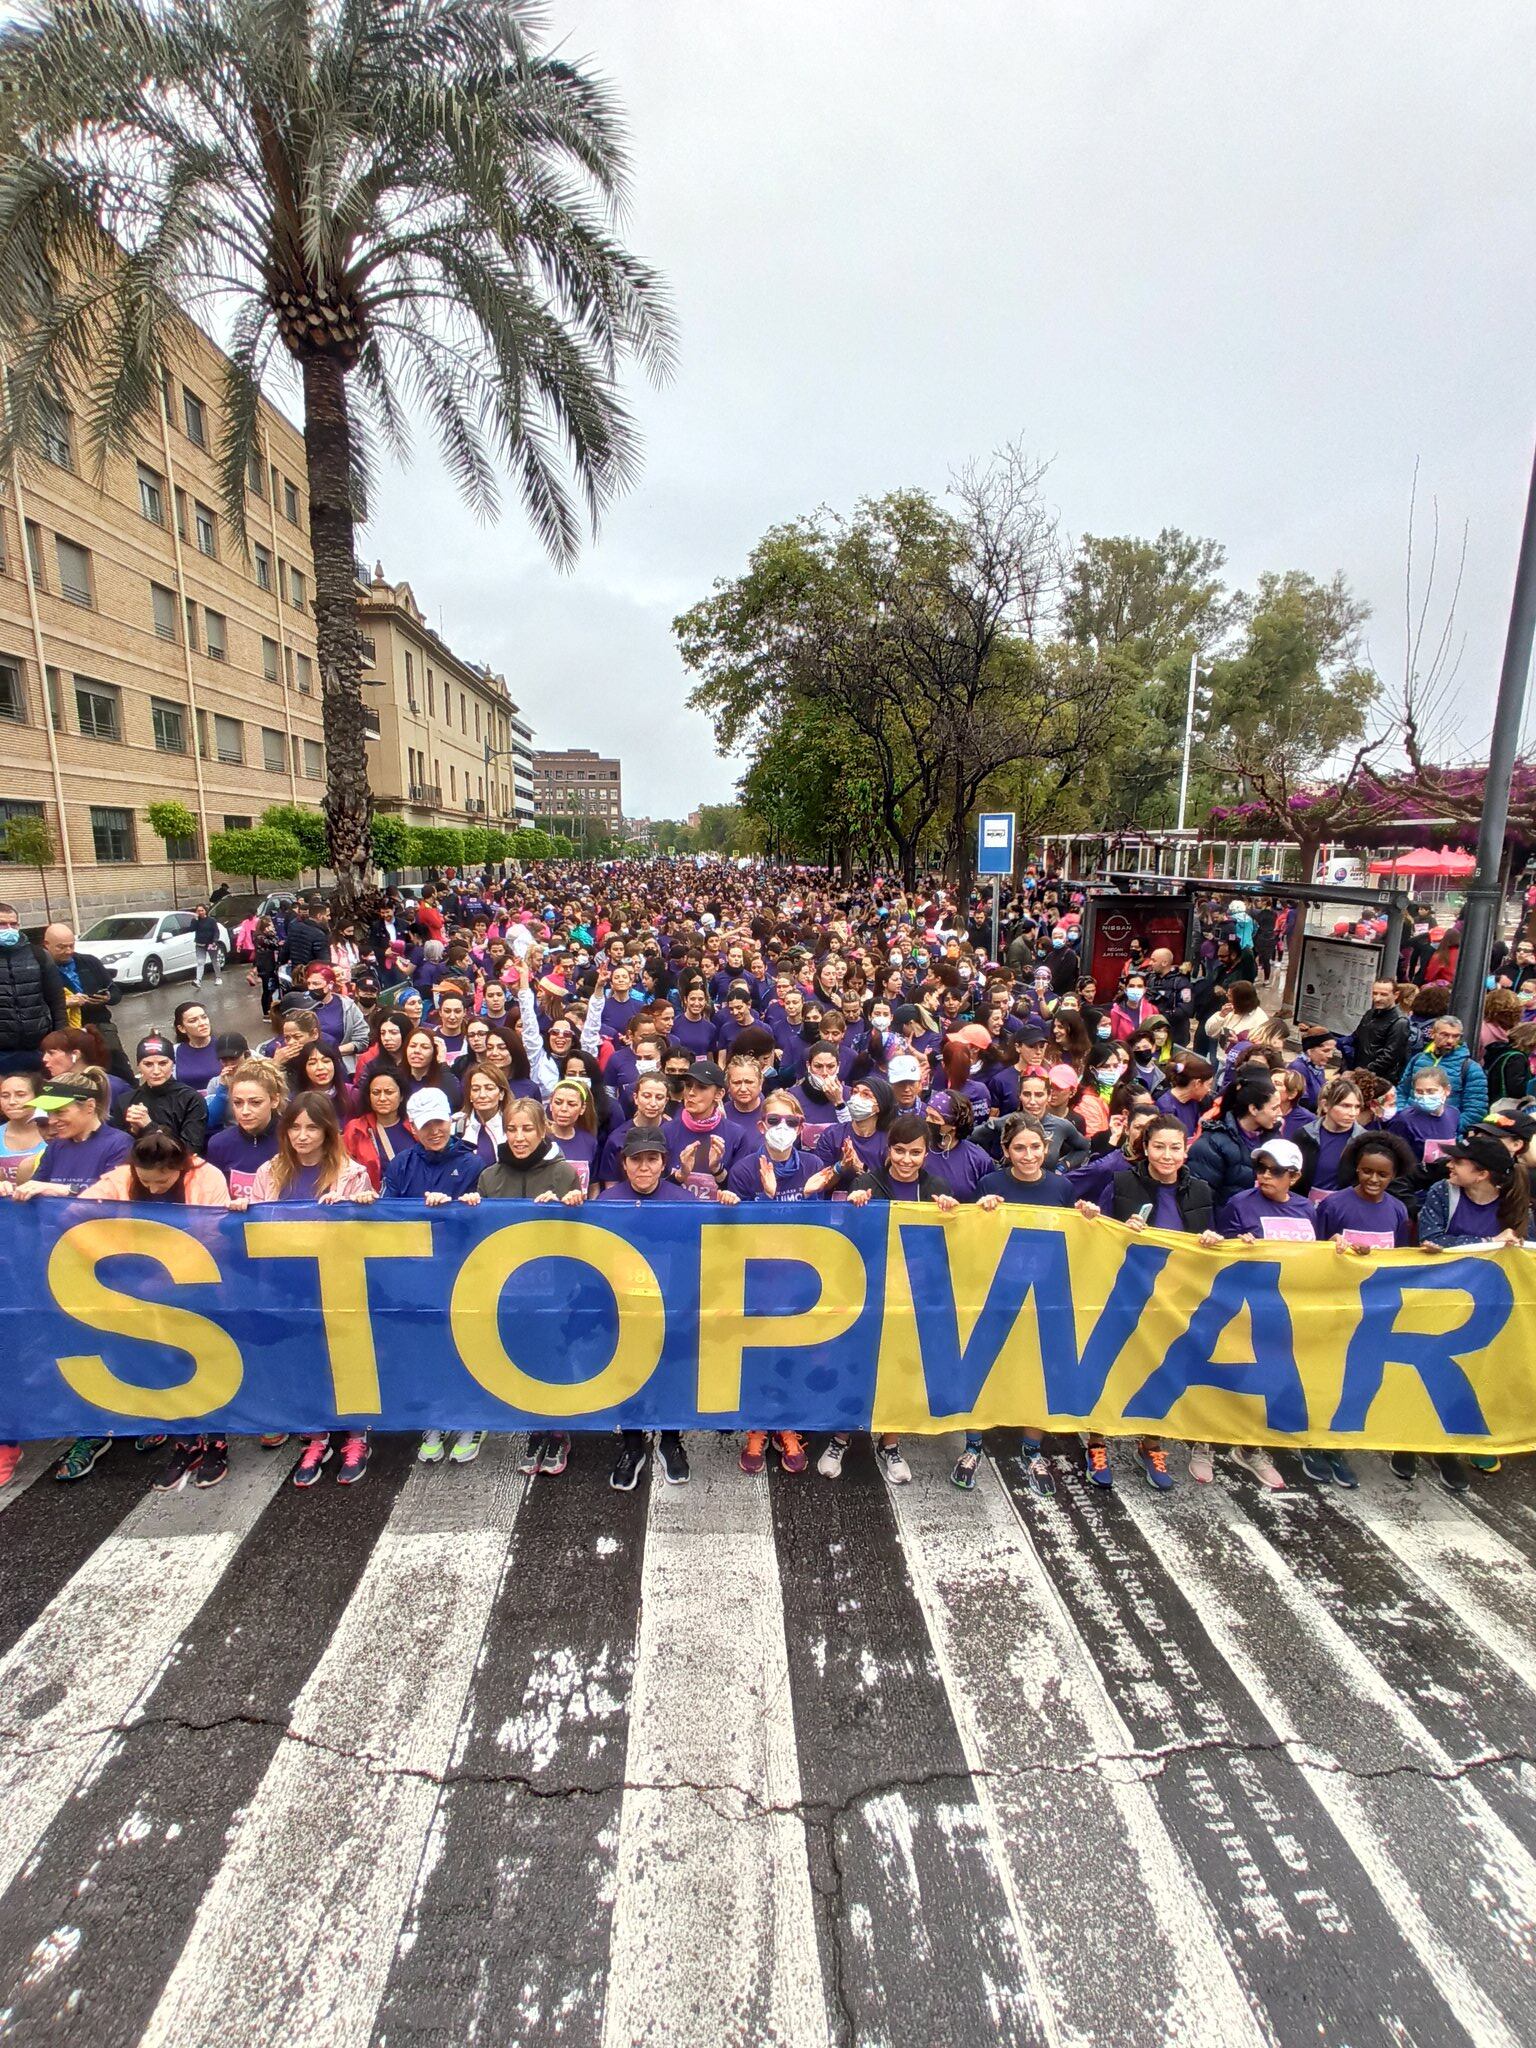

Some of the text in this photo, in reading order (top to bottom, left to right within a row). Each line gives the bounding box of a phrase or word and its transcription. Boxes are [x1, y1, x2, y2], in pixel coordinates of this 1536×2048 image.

[47, 1218, 1515, 1436] STOP WAR
[1059, 1474, 1129, 1561] personas
